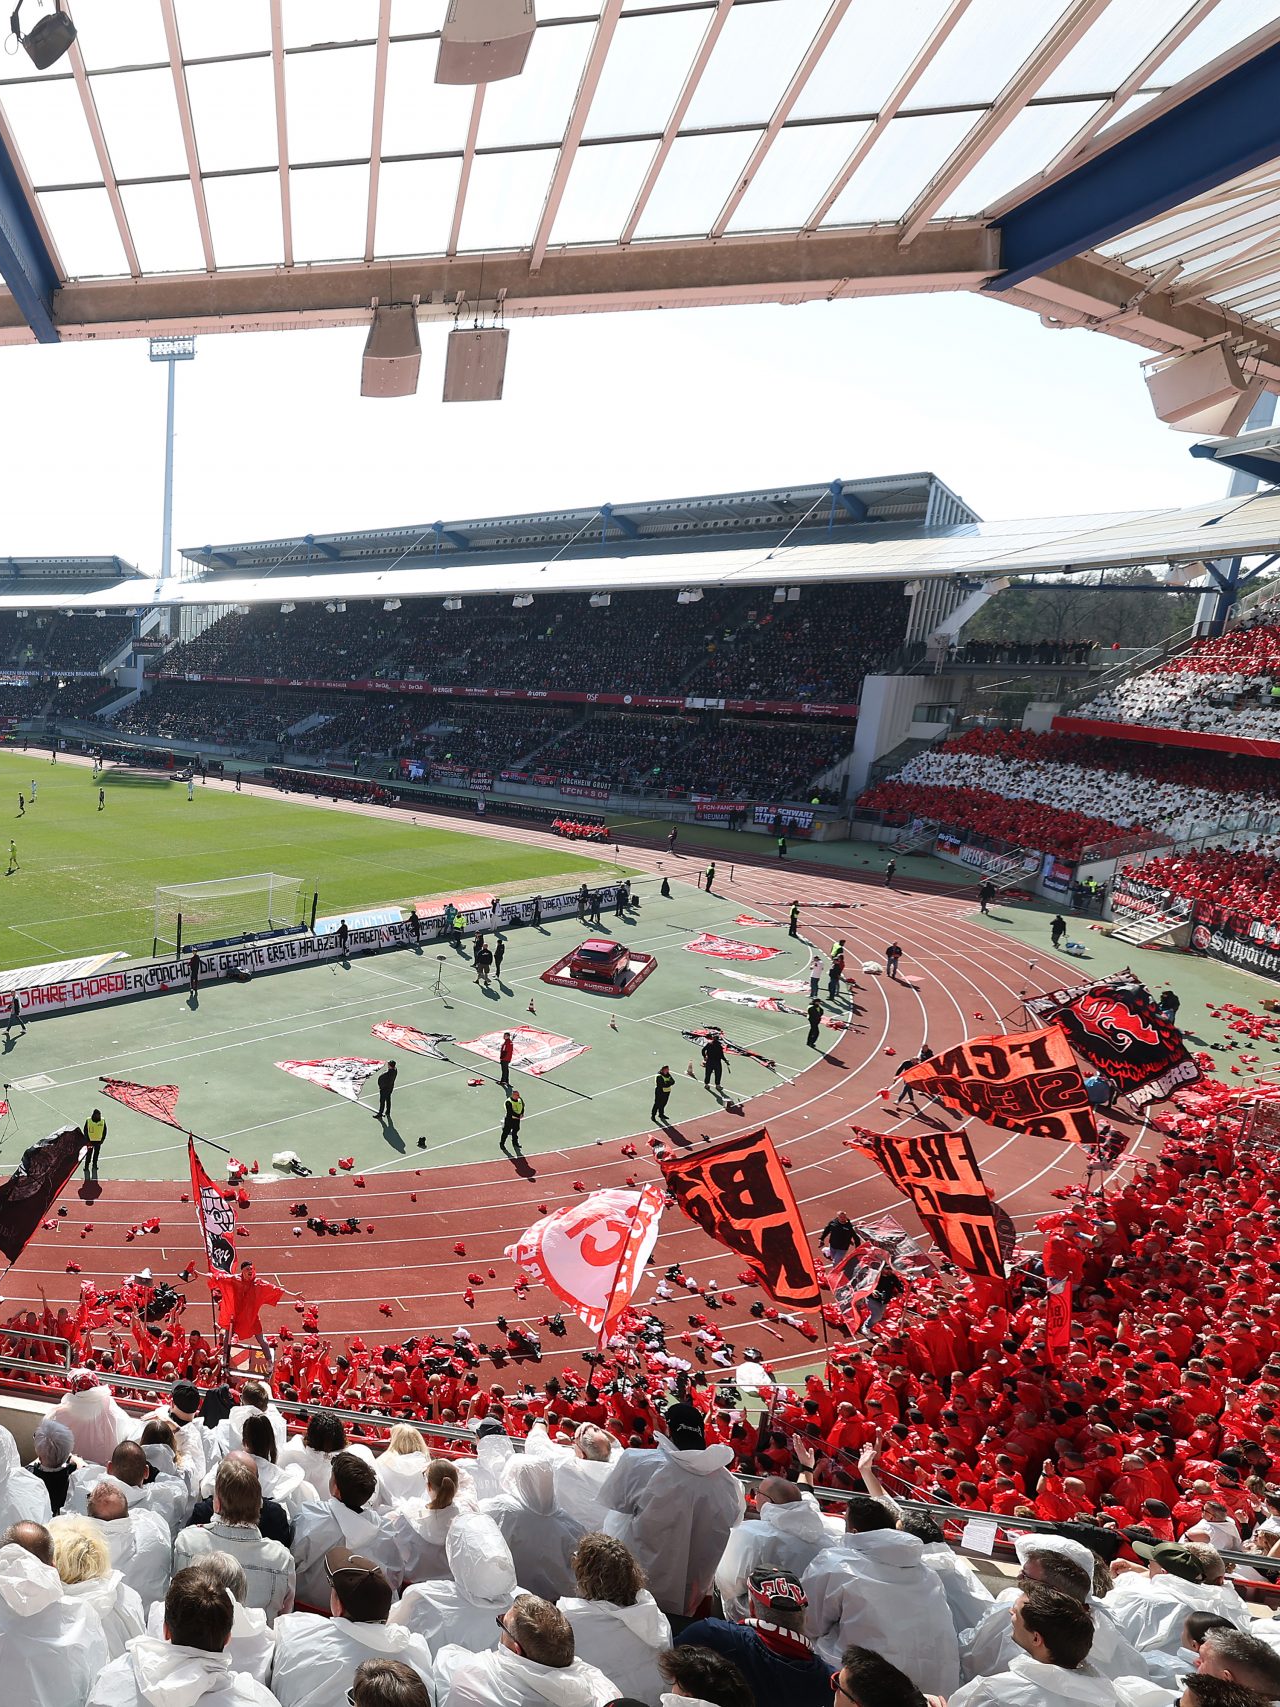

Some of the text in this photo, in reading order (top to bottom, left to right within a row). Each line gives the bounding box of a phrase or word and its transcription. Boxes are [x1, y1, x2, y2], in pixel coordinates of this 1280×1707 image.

[560, 777, 591, 787] FORCHHEIM
[561, 787, 583, 795] 1.FCN
[777, 808, 814, 819] SCHWARZ
[150, 960, 191, 984] PONCHO
[200, 958, 216, 974] DIE
[220, 950, 264, 971] GESAMTE
[268, 944, 297, 962] ERSTE
[299, 935, 342, 958] HALBZEIT
[760, 1577, 805, 1602] FCN
